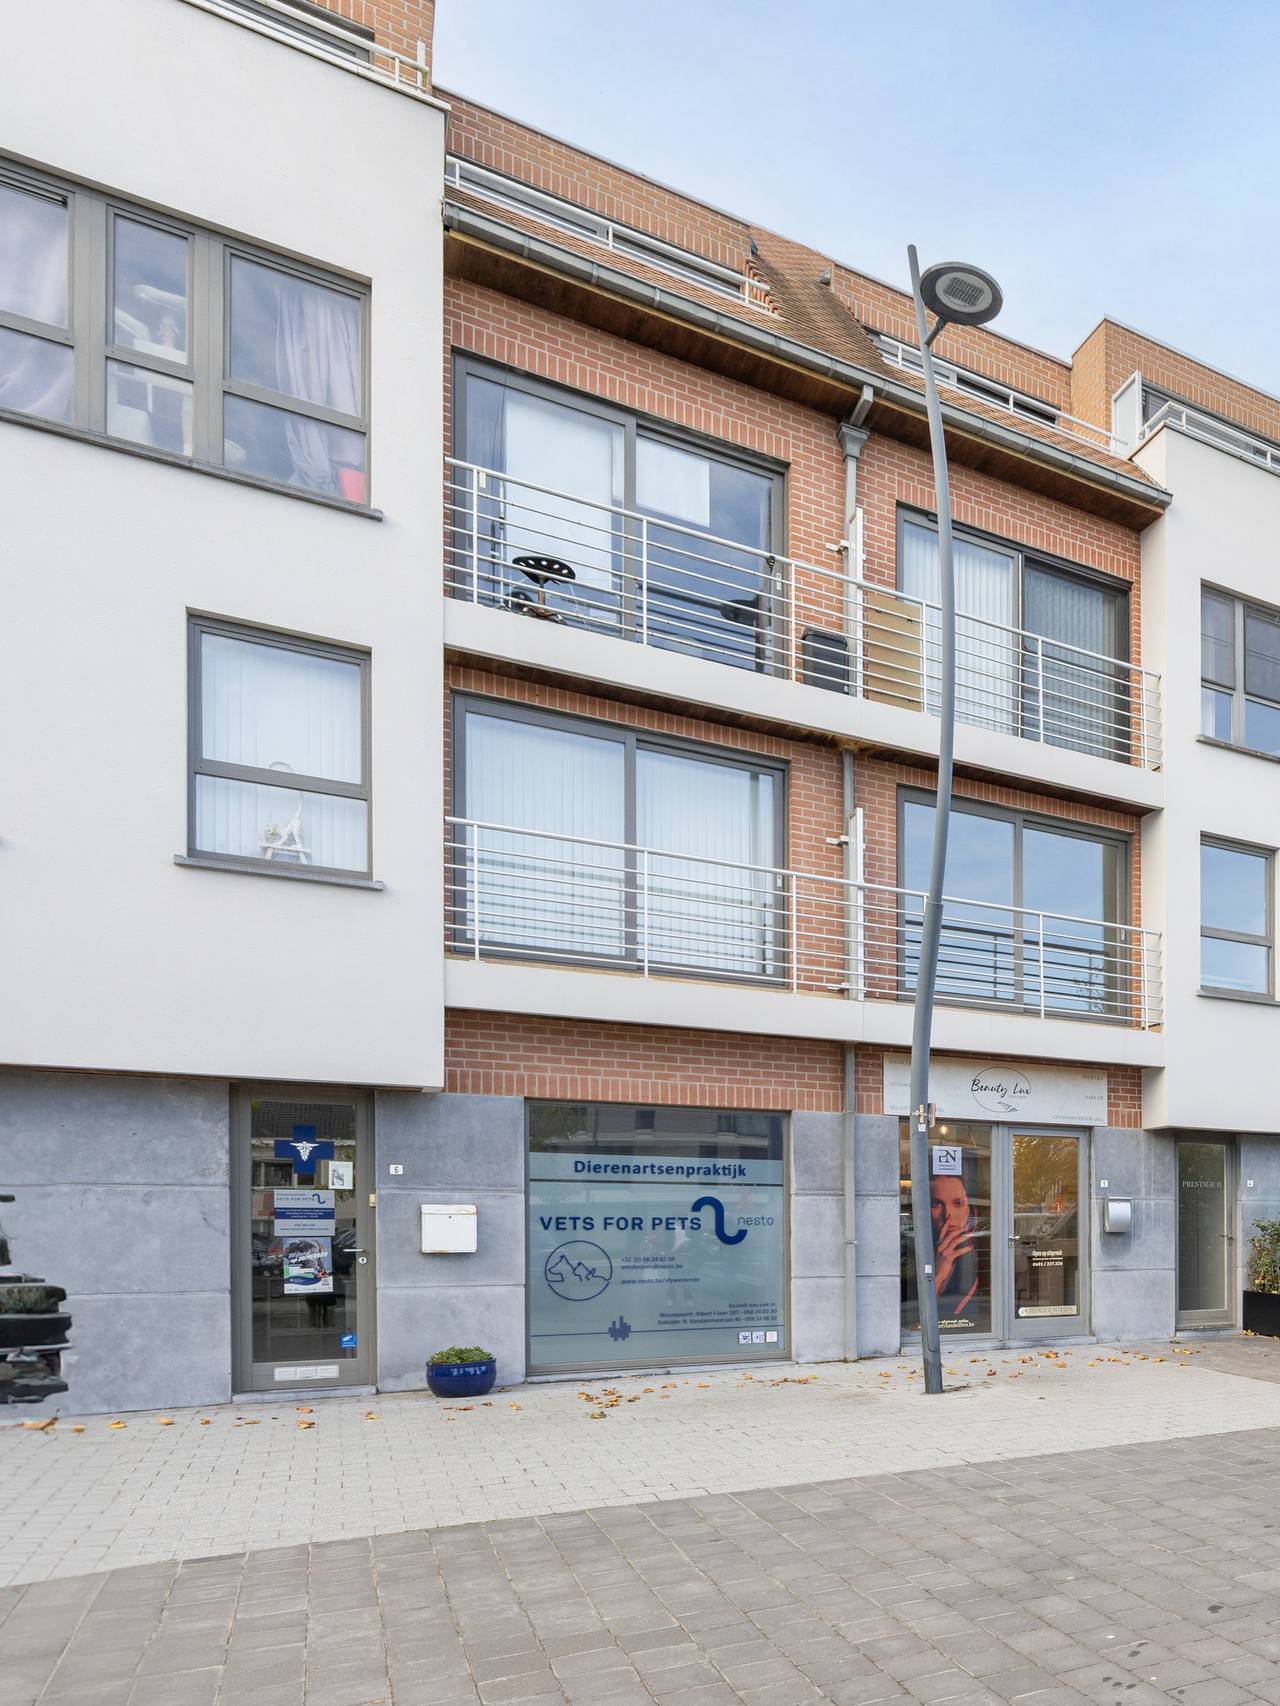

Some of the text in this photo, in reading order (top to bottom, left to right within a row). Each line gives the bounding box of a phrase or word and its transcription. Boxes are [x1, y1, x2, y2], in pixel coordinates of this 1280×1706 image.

[970, 1078, 1032, 1099] Beauty Lux
[574, 1160, 747, 1179] Dierenartsenpraktijk
[1182, 1180, 1216, 1188] PRESTIGE
[540, 1216, 702, 1231] VETS FOR PETS
[737, 1215, 775, 1226] nesto
